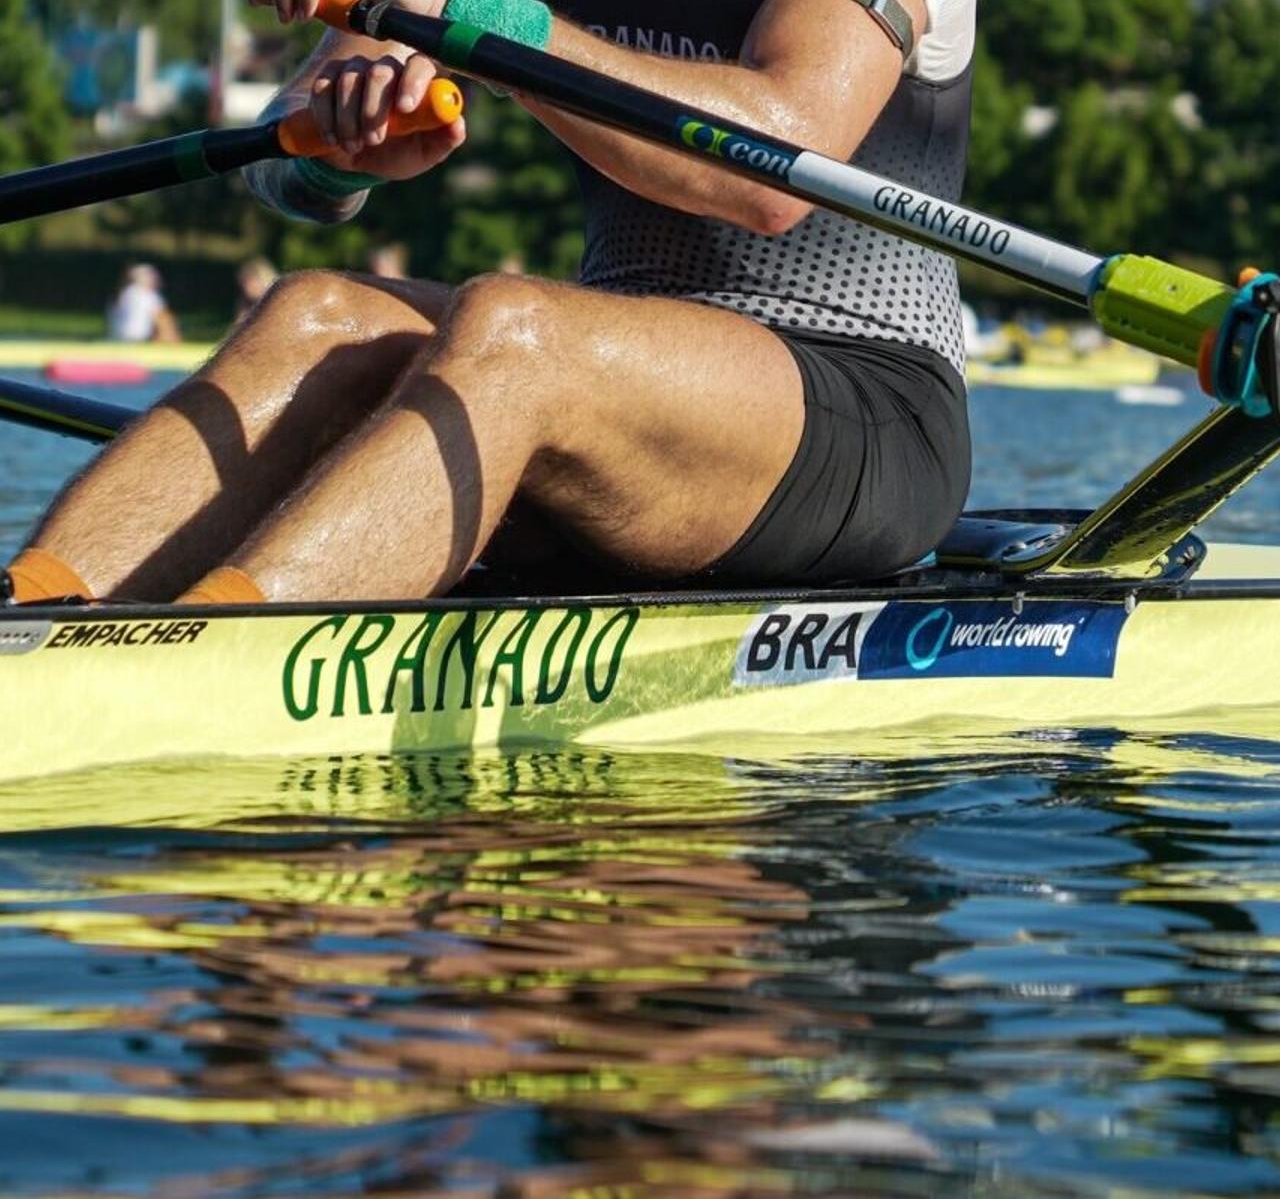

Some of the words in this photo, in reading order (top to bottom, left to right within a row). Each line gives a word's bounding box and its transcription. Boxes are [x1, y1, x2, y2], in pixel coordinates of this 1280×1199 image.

[586, 24, 721, 63] ANADO
[873, 185, 1011, 256] GRANADO
[45, 620, 208, 648] EMPACHER
[282, 607, 641, 721] GRANADO
[746, 612, 864, 672] BRA
